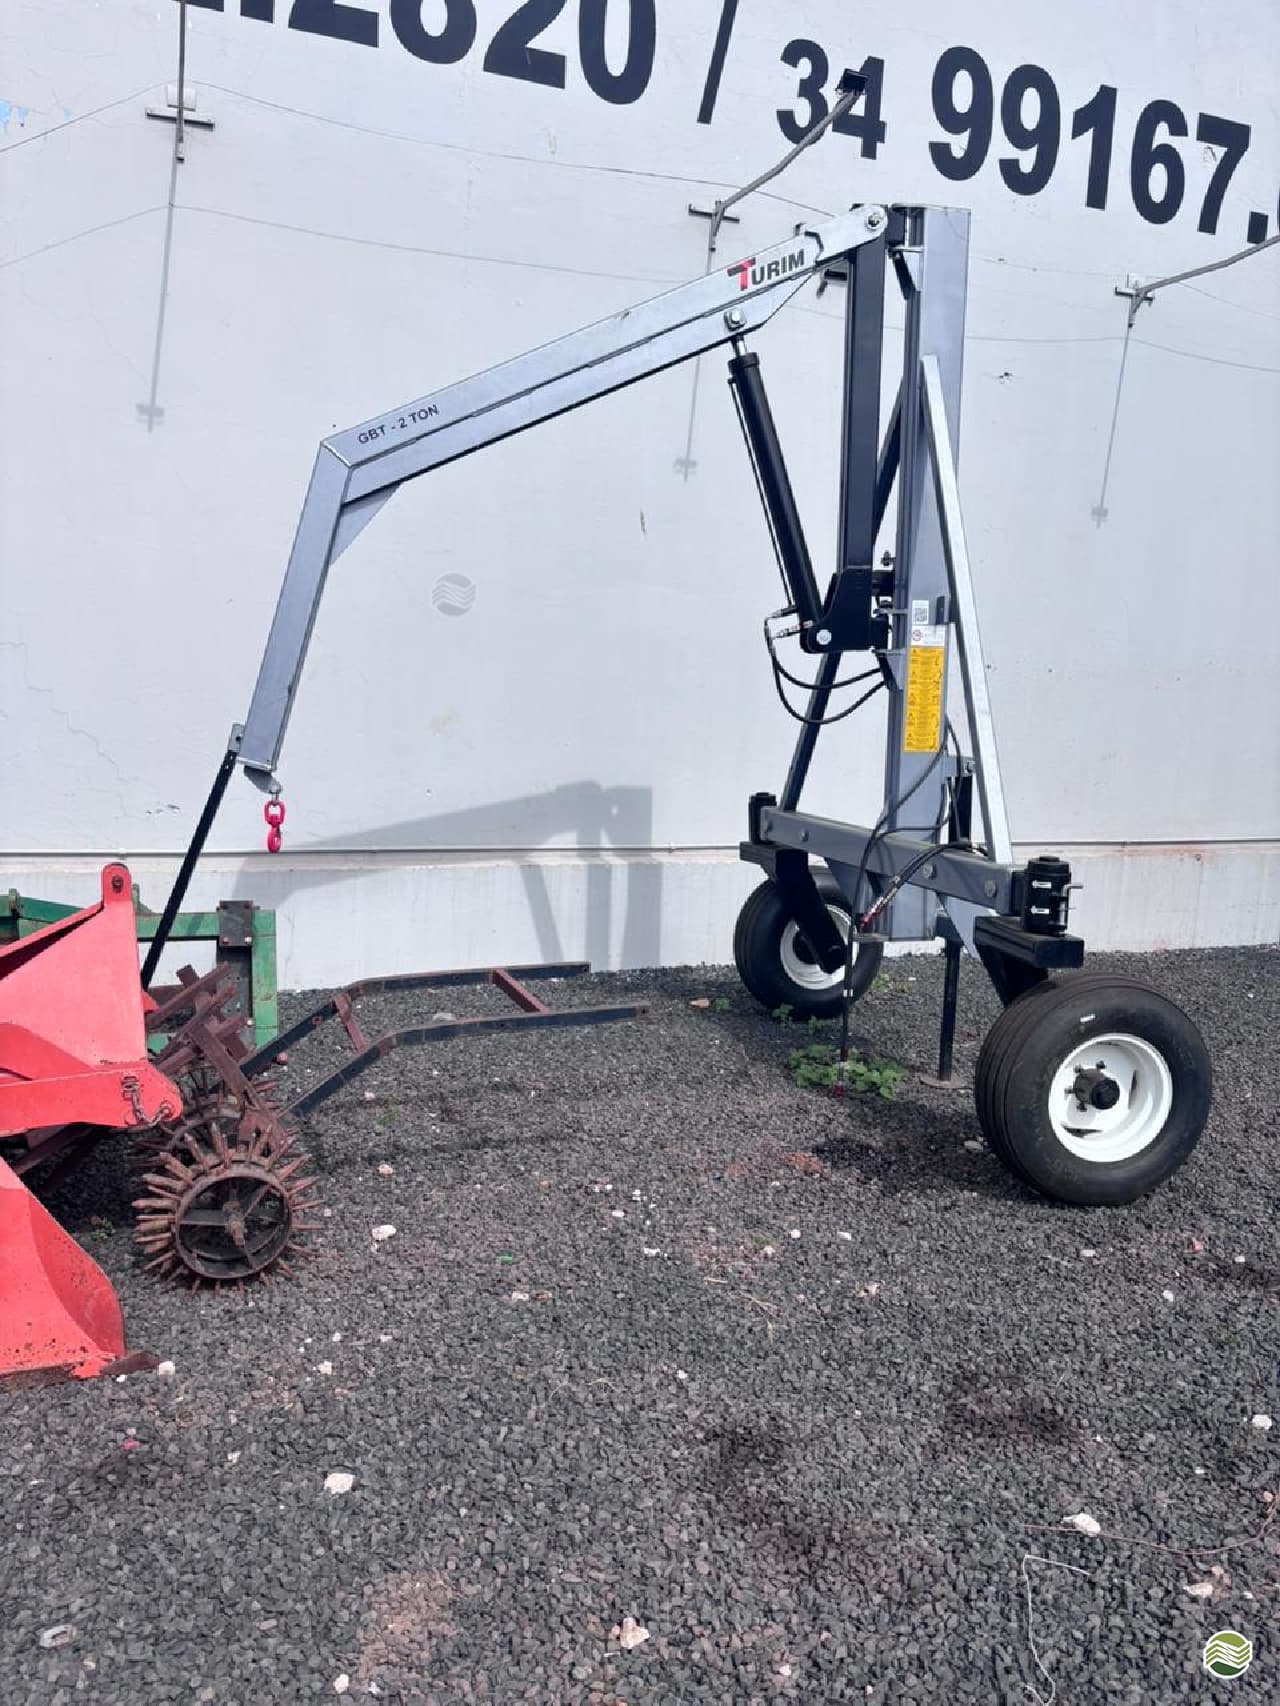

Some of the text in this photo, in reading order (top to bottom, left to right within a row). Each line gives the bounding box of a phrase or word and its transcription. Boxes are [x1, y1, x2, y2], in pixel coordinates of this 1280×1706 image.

[776, 39, 887, 160] 34
[928, 46, 1280, 244] 99167.
[727, 249, 804, 291] TURIM
[358, 425, 385, 444] GBT
[398, 416, 408, 429] 2
[408, 404, 439, 424] TON
